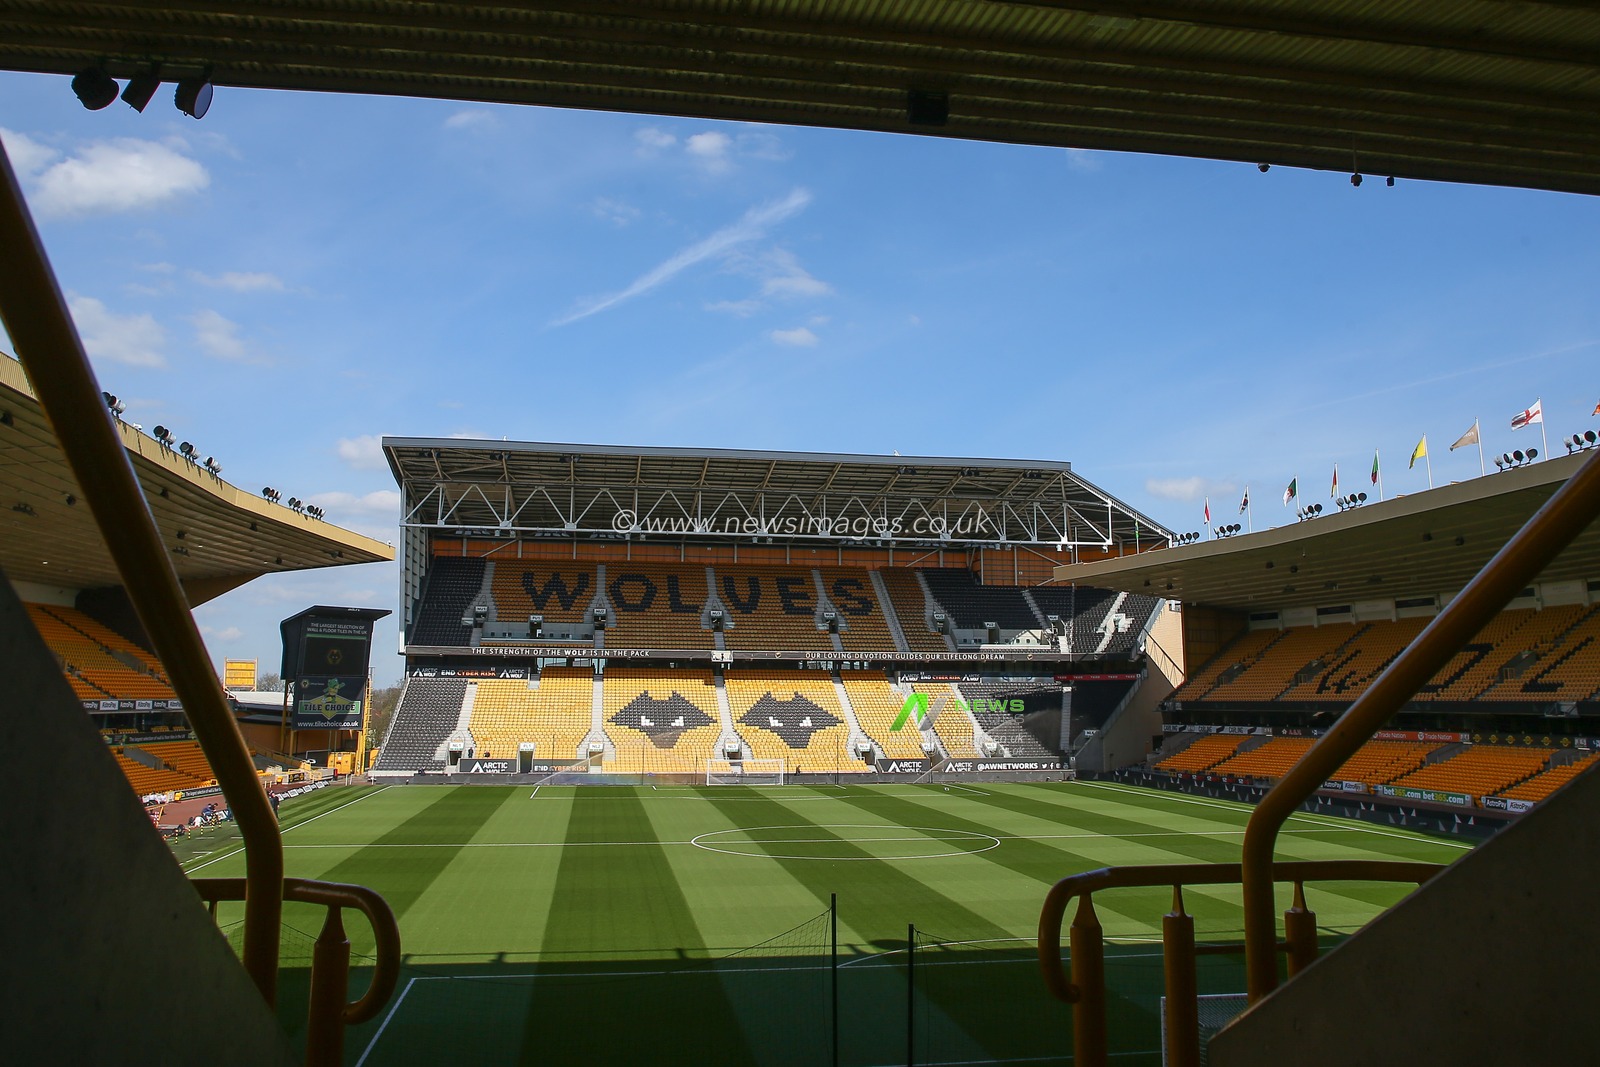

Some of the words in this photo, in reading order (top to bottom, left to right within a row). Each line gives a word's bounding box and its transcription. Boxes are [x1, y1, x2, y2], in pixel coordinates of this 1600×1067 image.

[522, 572, 874, 616] WOLVES
[977, 763, 1038, 771] @AWNETWORKS
[1384, 787, 1421, 799] bet365.com
[1422, 791, 1464, 804] bet365.com
[1486, 799, 1506, 809] AstroPay
